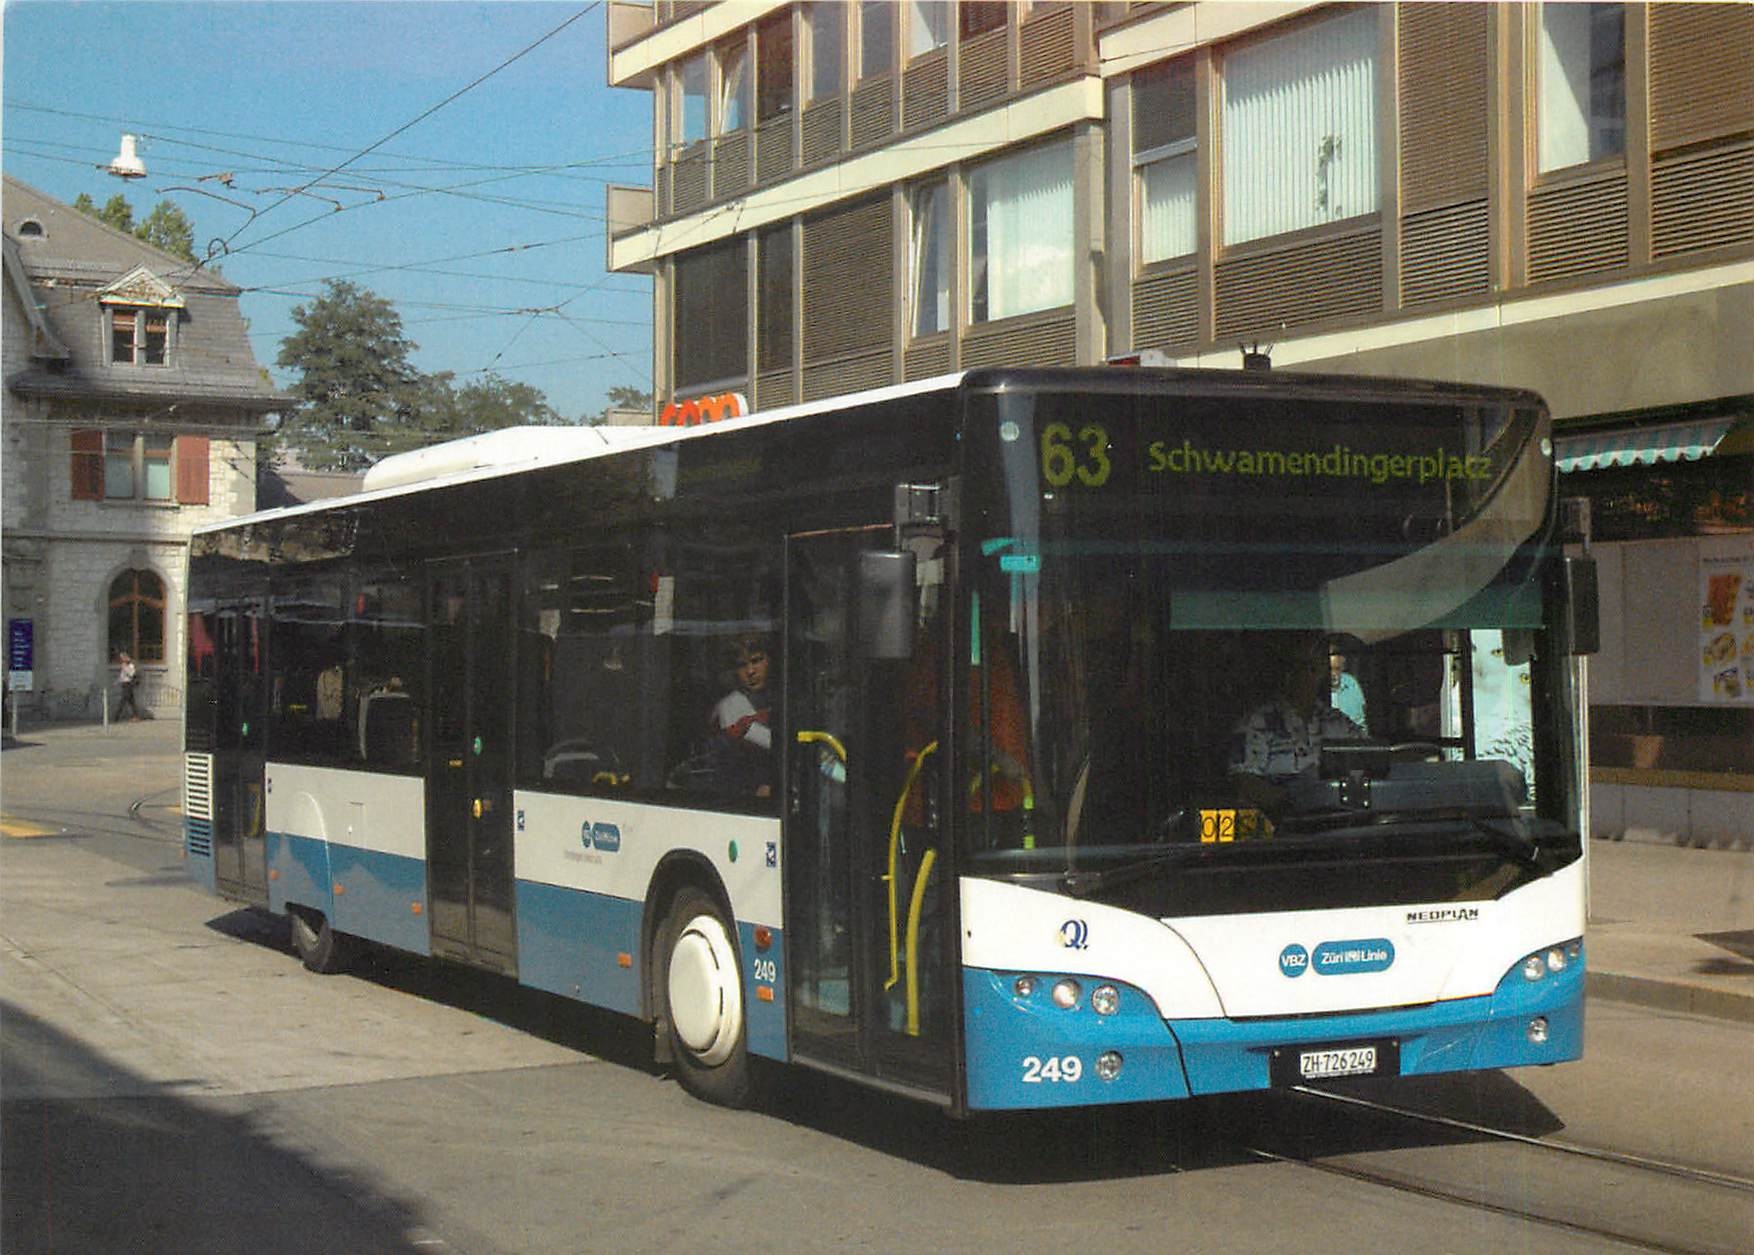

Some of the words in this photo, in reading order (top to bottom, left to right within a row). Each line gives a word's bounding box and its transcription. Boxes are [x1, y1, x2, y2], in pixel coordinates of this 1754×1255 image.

[1041, 423, 1110, 486] 63
[1149, 440, 1492, 484] Schwamendingerplatz
[754, 958, 776, 982] 249
[1281, 953, 1306, 966] VBZ
[1022, 1056, 1082, 1082] 249
